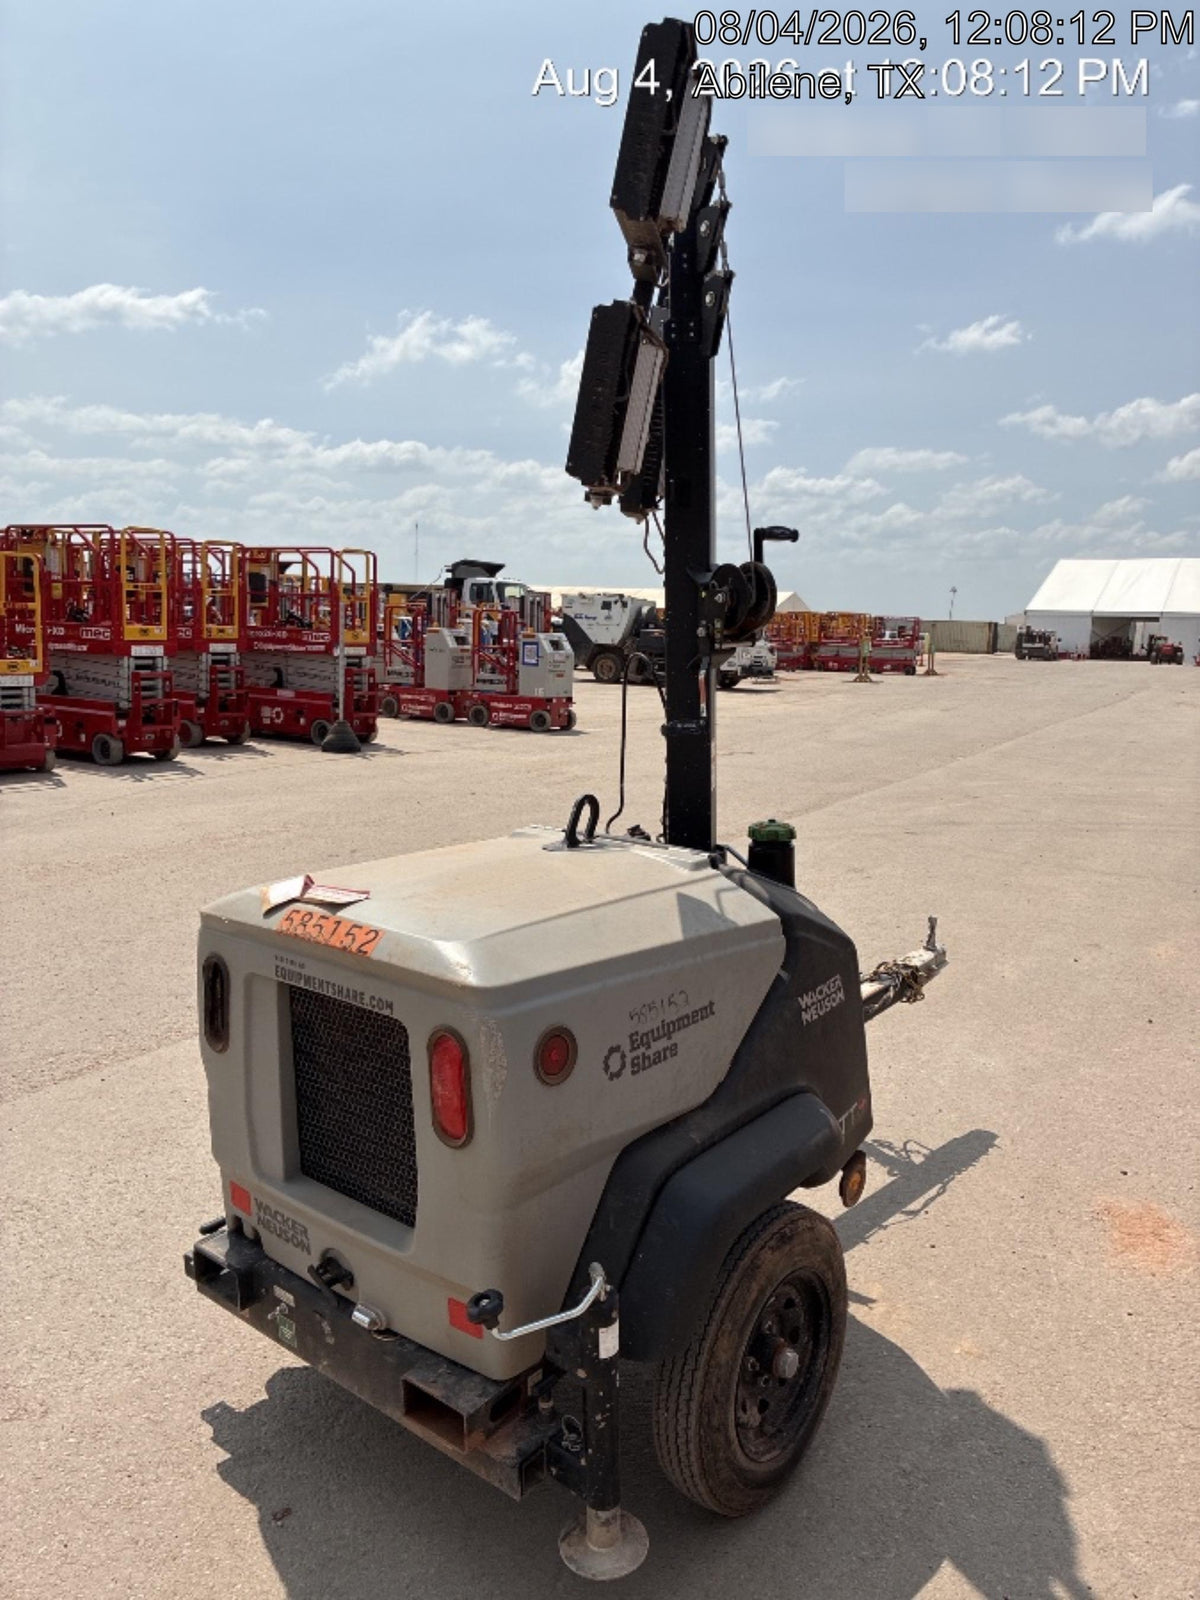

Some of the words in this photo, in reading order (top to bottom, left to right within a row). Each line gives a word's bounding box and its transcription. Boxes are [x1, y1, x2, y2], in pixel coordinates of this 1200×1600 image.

[282, 908, 379, 956] 585152
[273, 964, 394, 1015] EQUIPMENTSHARE.COM
[801, 986, 845, 1027] NEUSON
[628, 1000, 716, 1054] Equipment
[630, 1042, 678, 1076] Share
[254, 1197, 310, 1241] WACKER
[256, 1213, 312, 1253] NEUSON
